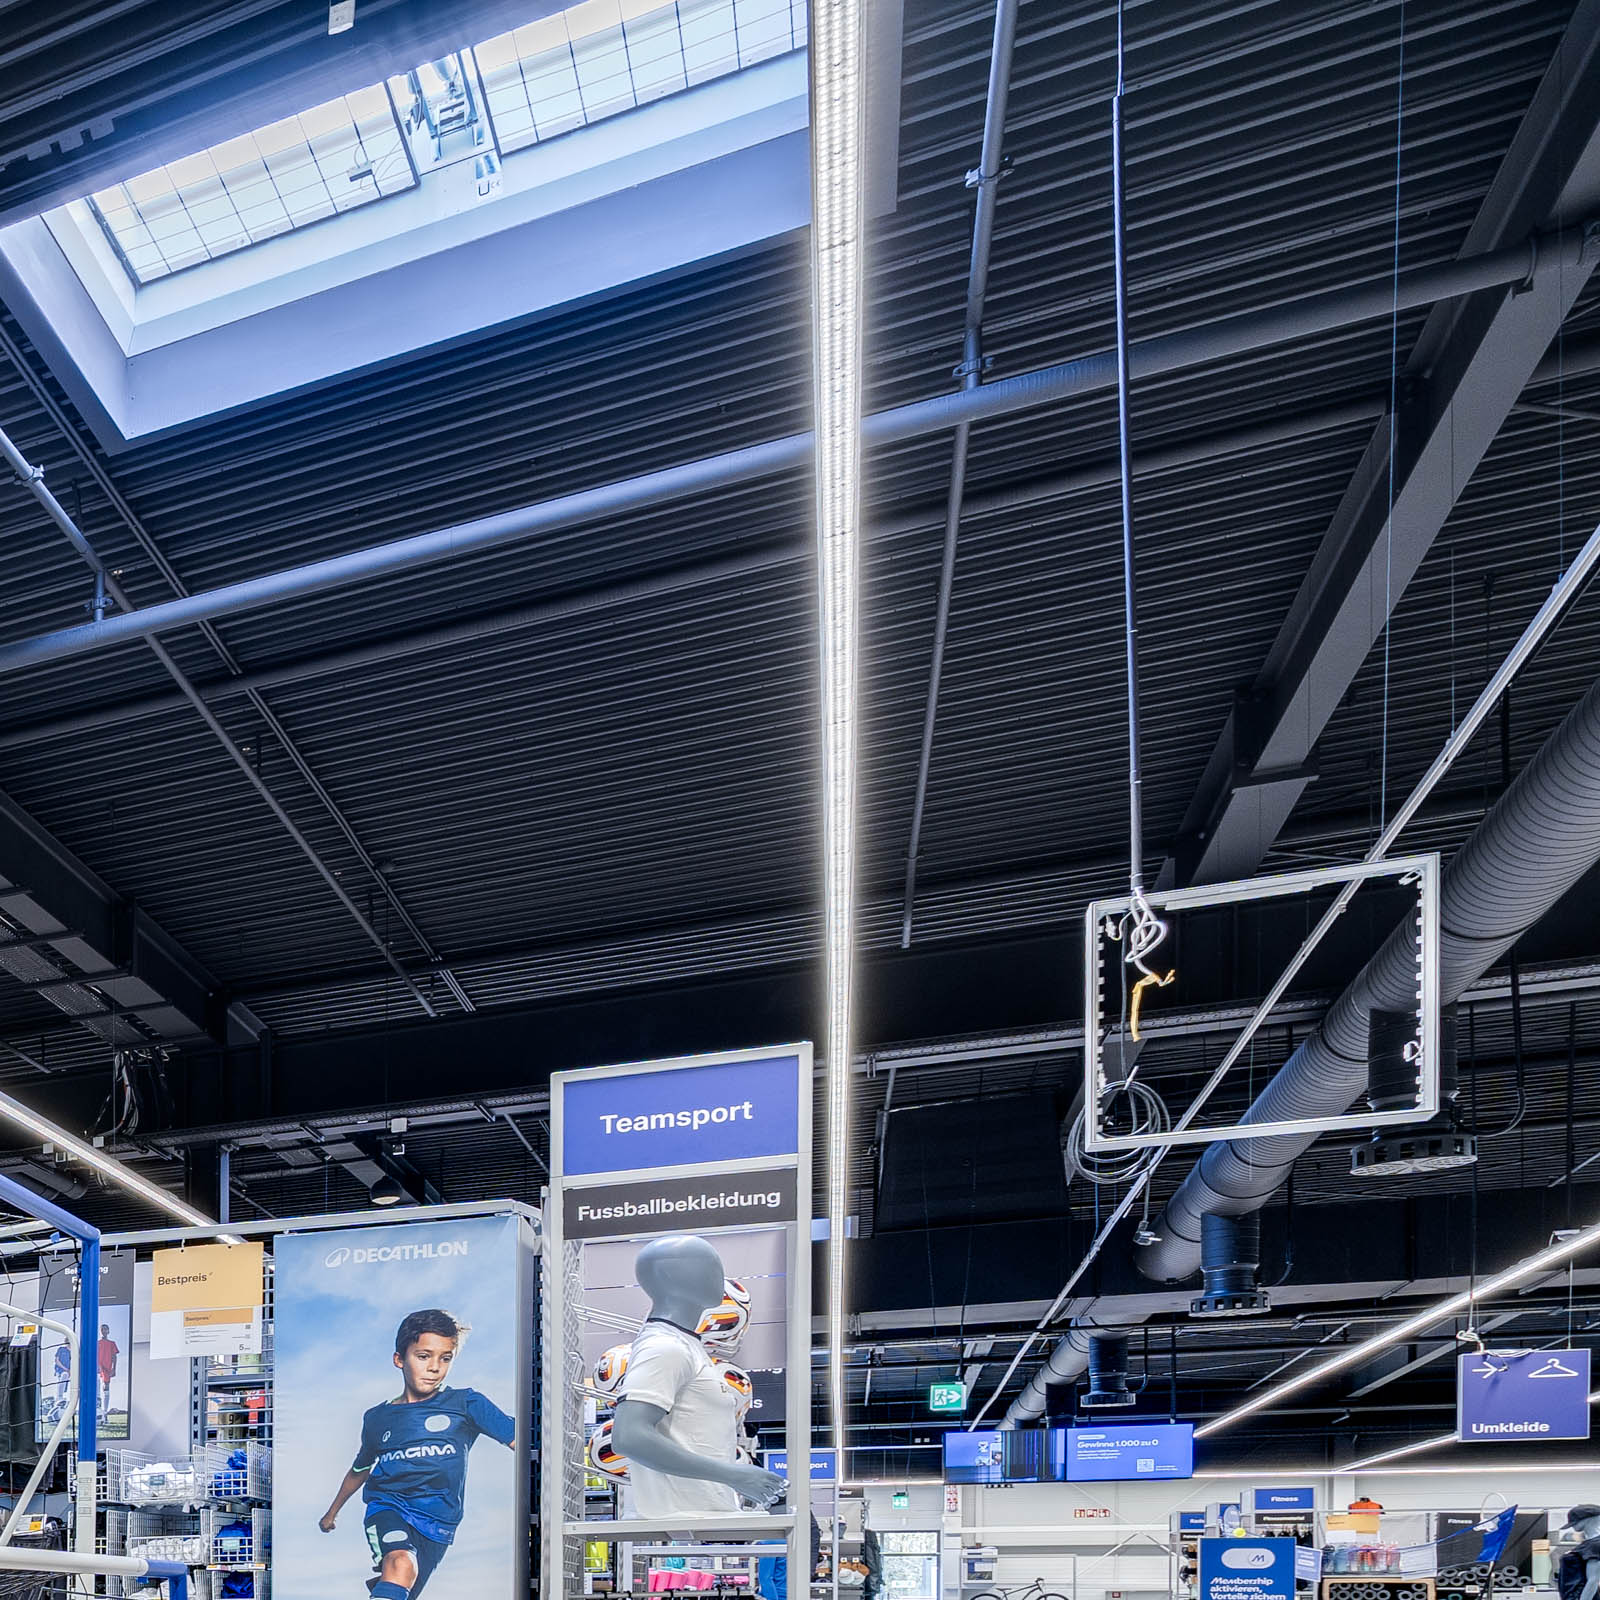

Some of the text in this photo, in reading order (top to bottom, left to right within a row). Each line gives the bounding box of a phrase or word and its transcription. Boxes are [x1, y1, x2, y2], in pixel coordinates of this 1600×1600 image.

[600, 1101, 753, 1134] Teamsport
[578, 1191, 781, 1221] Fussballbekleidung
[353, 1241, 468, 1264] DECATHLON
[158, 1273, 207, 1286] Bestpreis
[1472, 1422, 1550, 1434] Umkleide
[1077, 1441, 1114, 1449] Gewinne
[1115, 1440, 1139, 1448] 1.000
[380, 1444, 456, 1464] MAGMA
[1210, 1577, 1274, 1585] Membership
[1210, 1585, 1262, 1593] aktivieren,
[1210, 1593, 1286, 1600] Vorteile sichern
